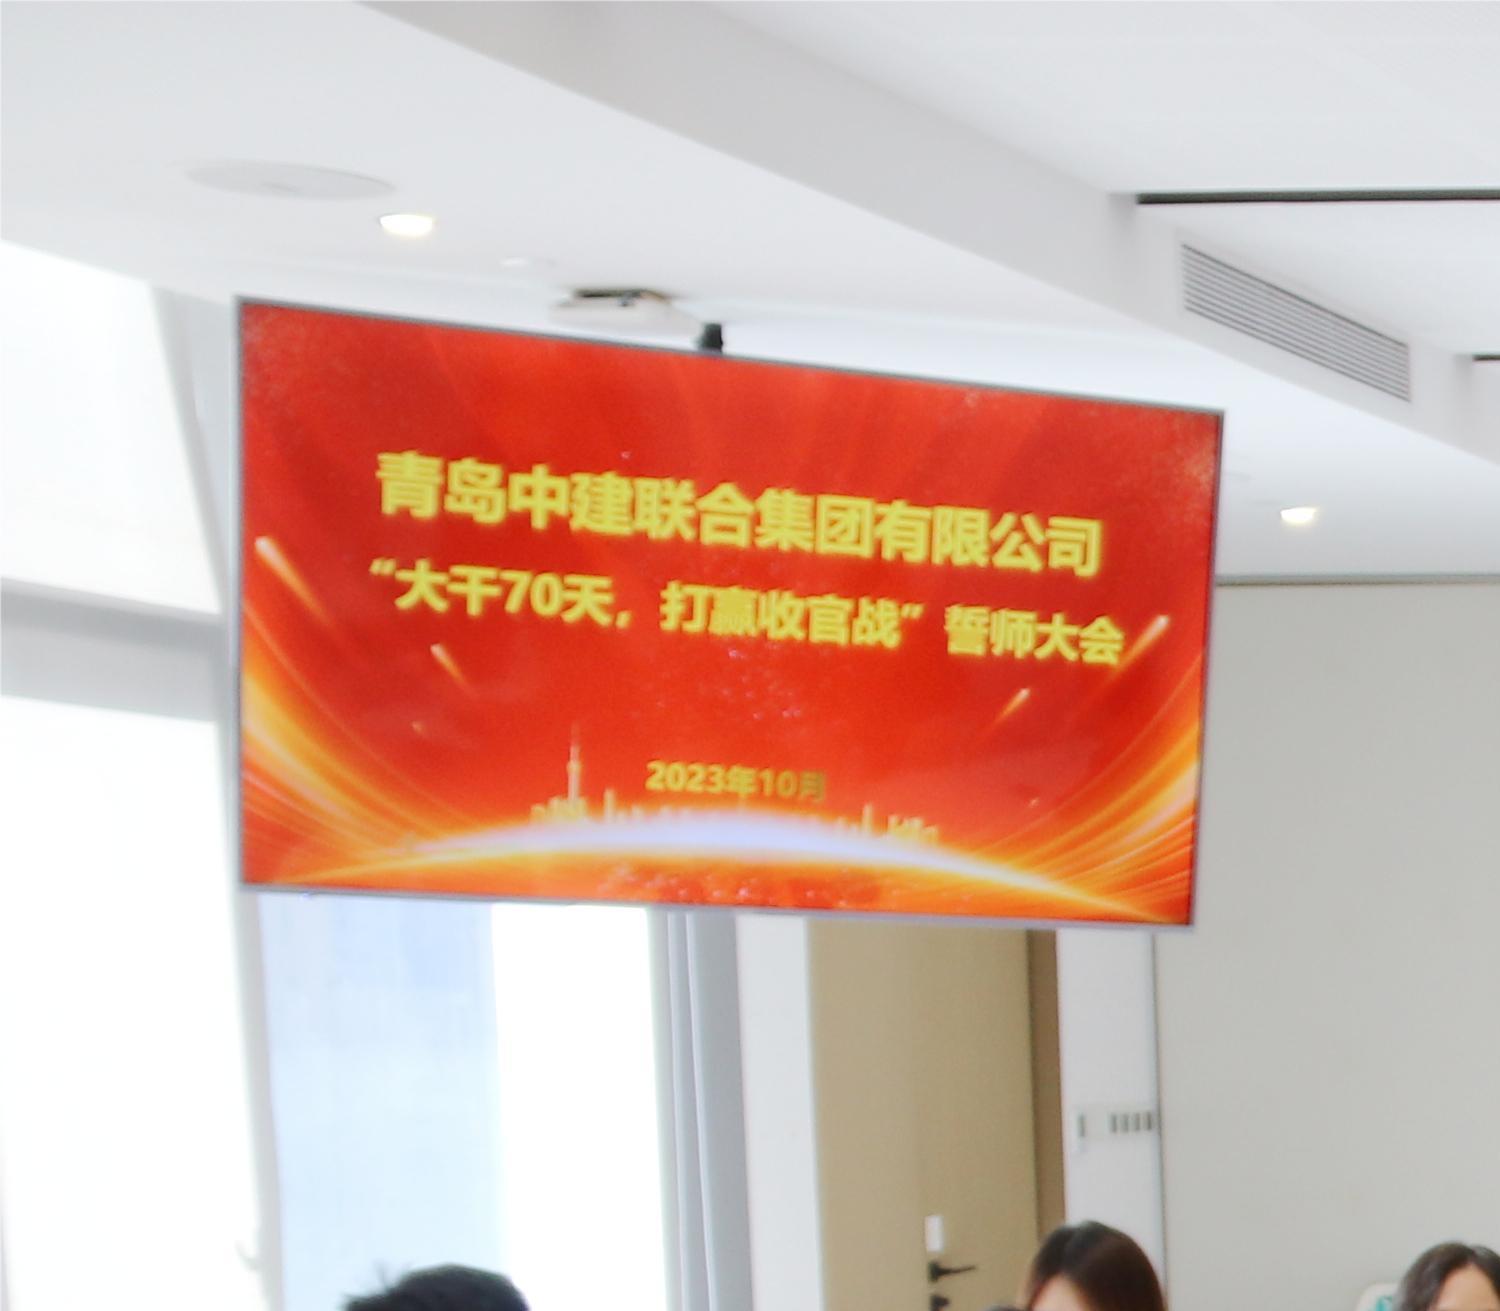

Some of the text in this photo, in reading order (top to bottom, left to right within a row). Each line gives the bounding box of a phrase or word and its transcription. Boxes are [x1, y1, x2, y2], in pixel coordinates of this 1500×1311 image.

[375, 450, 1101, 577] 青岛中建联合集团有限公司
[644, 759, 826, 801] 2023年10月
